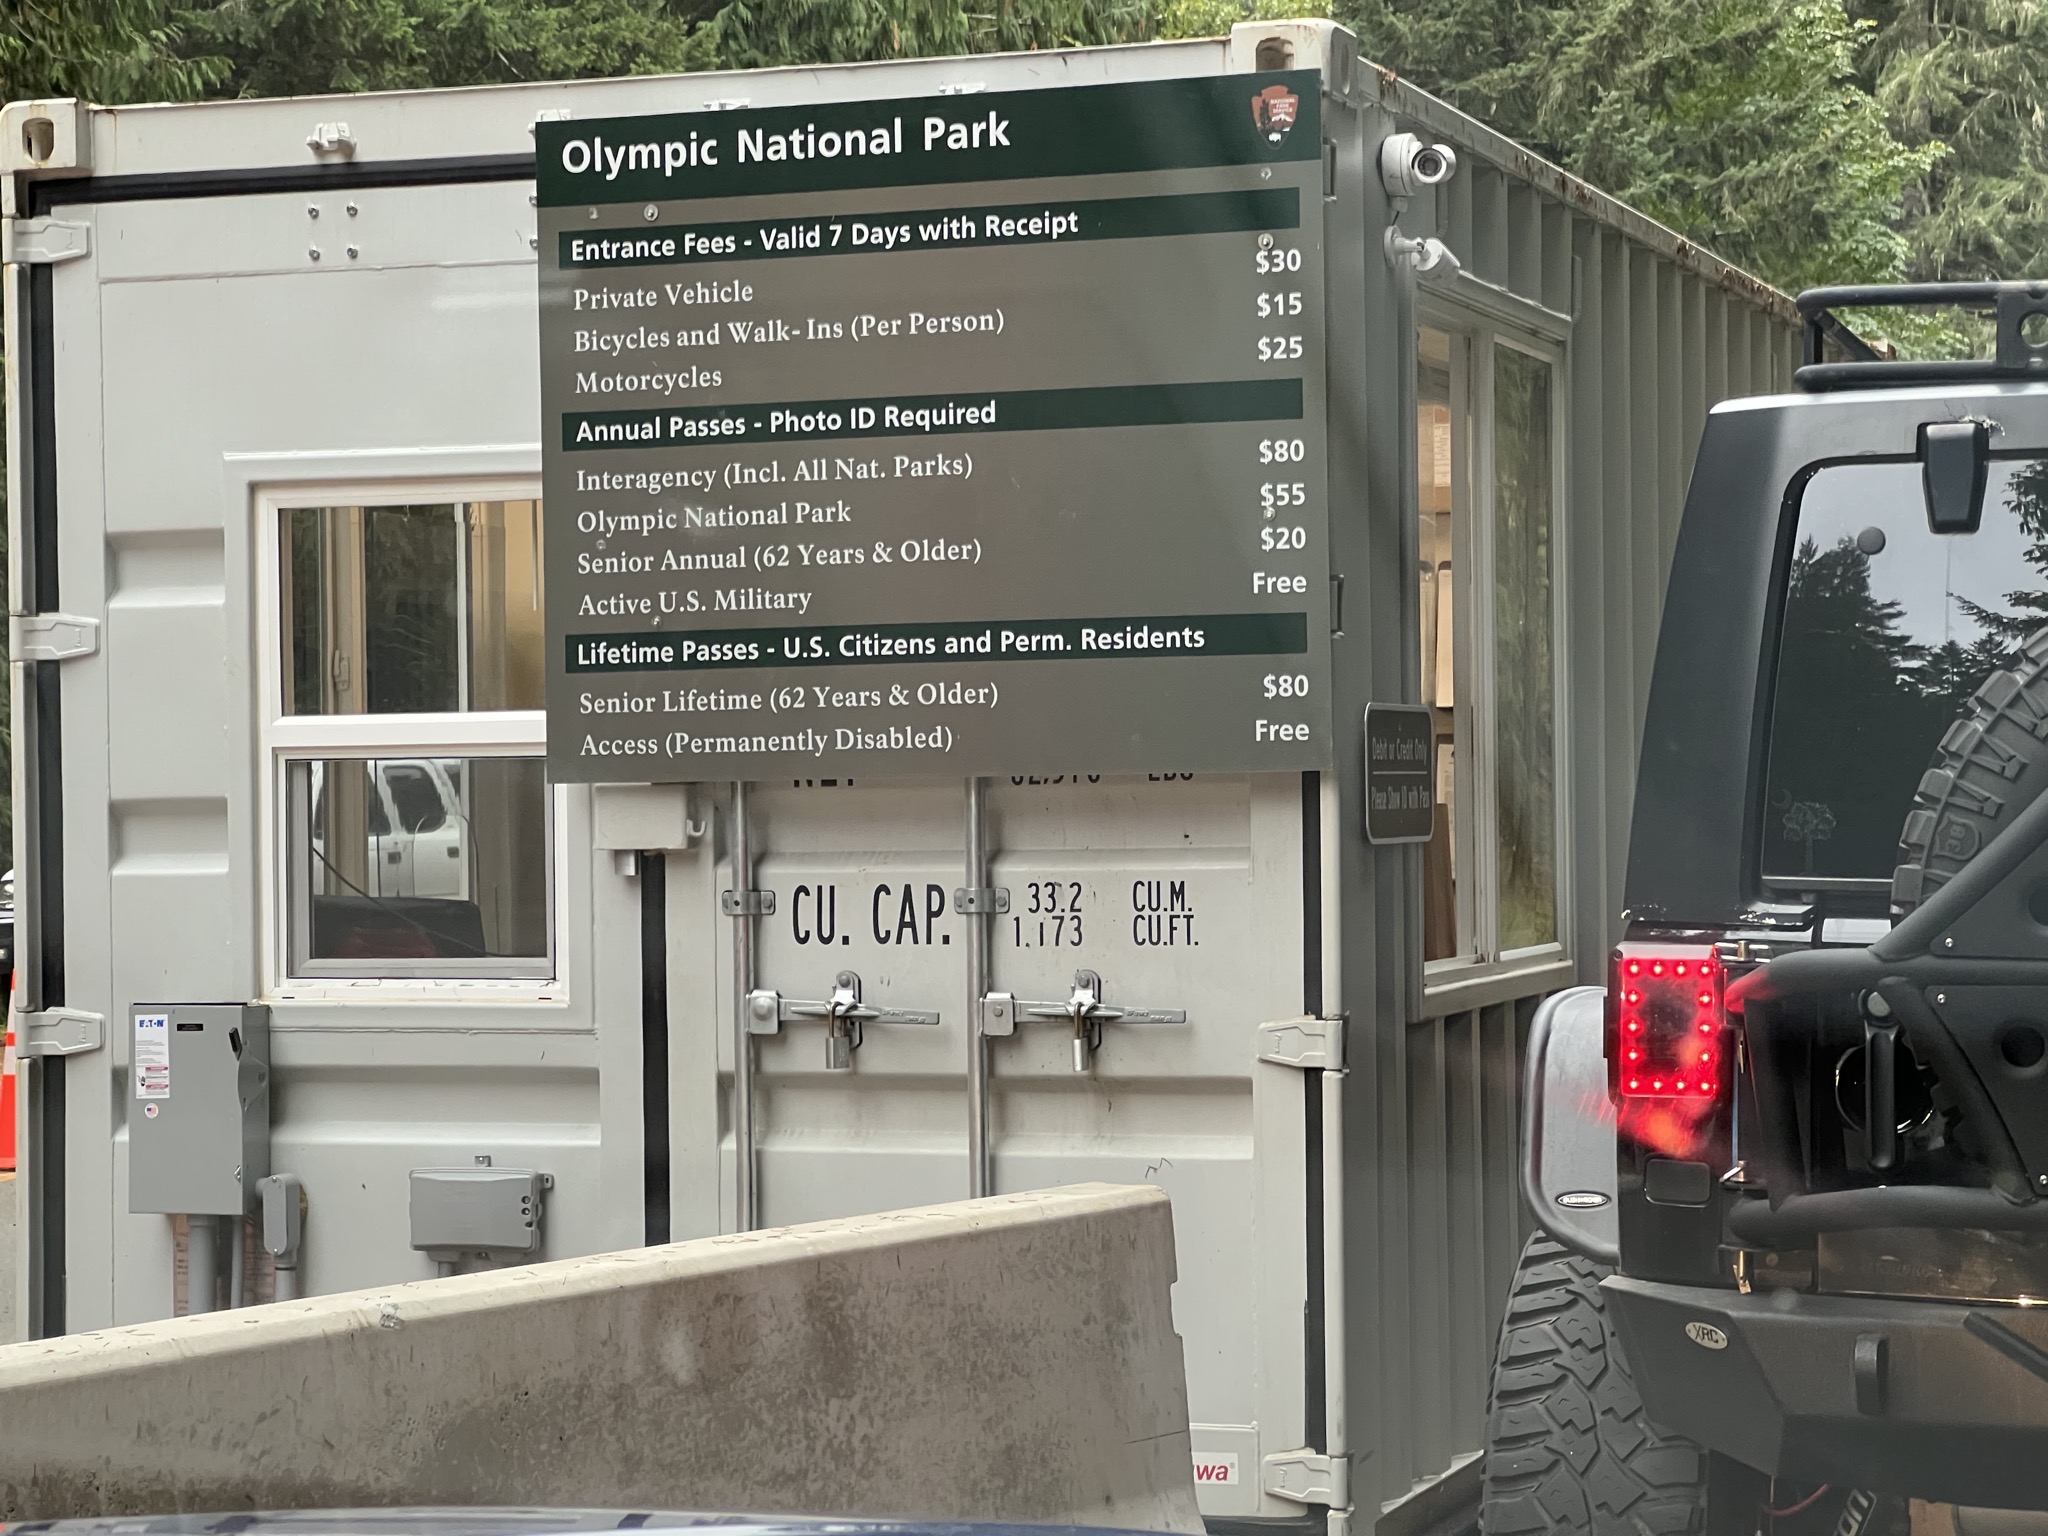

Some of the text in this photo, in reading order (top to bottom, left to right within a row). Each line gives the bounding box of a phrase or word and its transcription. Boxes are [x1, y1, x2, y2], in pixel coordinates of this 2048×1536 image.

[562, 110, 1011, 181] Olympic National Park
[571, 239, 676, 262] Entrance
[684, 233, 736, 256] Fees
[759, 224, 821, 251] Valid
[829, 224, 843, 247] 7
[851, 223, 911, 250] Days
[918, 215, 976, 242] with
[985, 210, 1079, 240] Receipt
[573, 248, 1302, 311] Private Vehicle $30
[574, 326, 670, 357] Bicycles
[676, 322, 720, 347] and
[851, 315, 902, 342] (Per
[908, 308, 1004, 335] Person)
[1257, 292, 1302, 319] $15
[575, 335, 1303, 396] Motorcycles $25
[575, 416, 661, 443] Annual
[669, 416, 746, 438] Passes
[770, 409, 842, 433] Photo
[850, 407, 876, 430] ID
[884, 399, 996, 432] Required
[576, 438, 1305, 495] Interagency (Incl. All Nat. Parks) $80
[577, 482, 1306, 538] Olympic National Park $55
[578, 525, 1306, 575] Senior Annual (62 Years & Older) $20
[578, 571, 1307, 616] Active U.S. Military Free
[578, 641, 674, 665] Lifetime
[682, 640, 759, 662] Passes
[783, 636, 830, 659] U.S.
[839, 633, 936, 657] Citizens
[944, 629, 991, 654] and
[1000, 630, 1072, 653] Perm.
[1081, 625, 1205, 650] Residents
[580, 673, 1309, 714] Senior Lifetime (62 Years & Older) $80
[579, 719, 1310, 759] Access (Permanently Disabled) Free
[1372, 736, 1427, 766] Debit or Credit Only
[792, 883, 950, 946] CU. CAP.
[1027, 880, 1193, 914] 33.2 CU.M.
[1133, 914, 1199, 946] CU.FT.
[1692, 1323, 1720, 1344] XRC
[1196, 1464, 1229, 1481] wa
